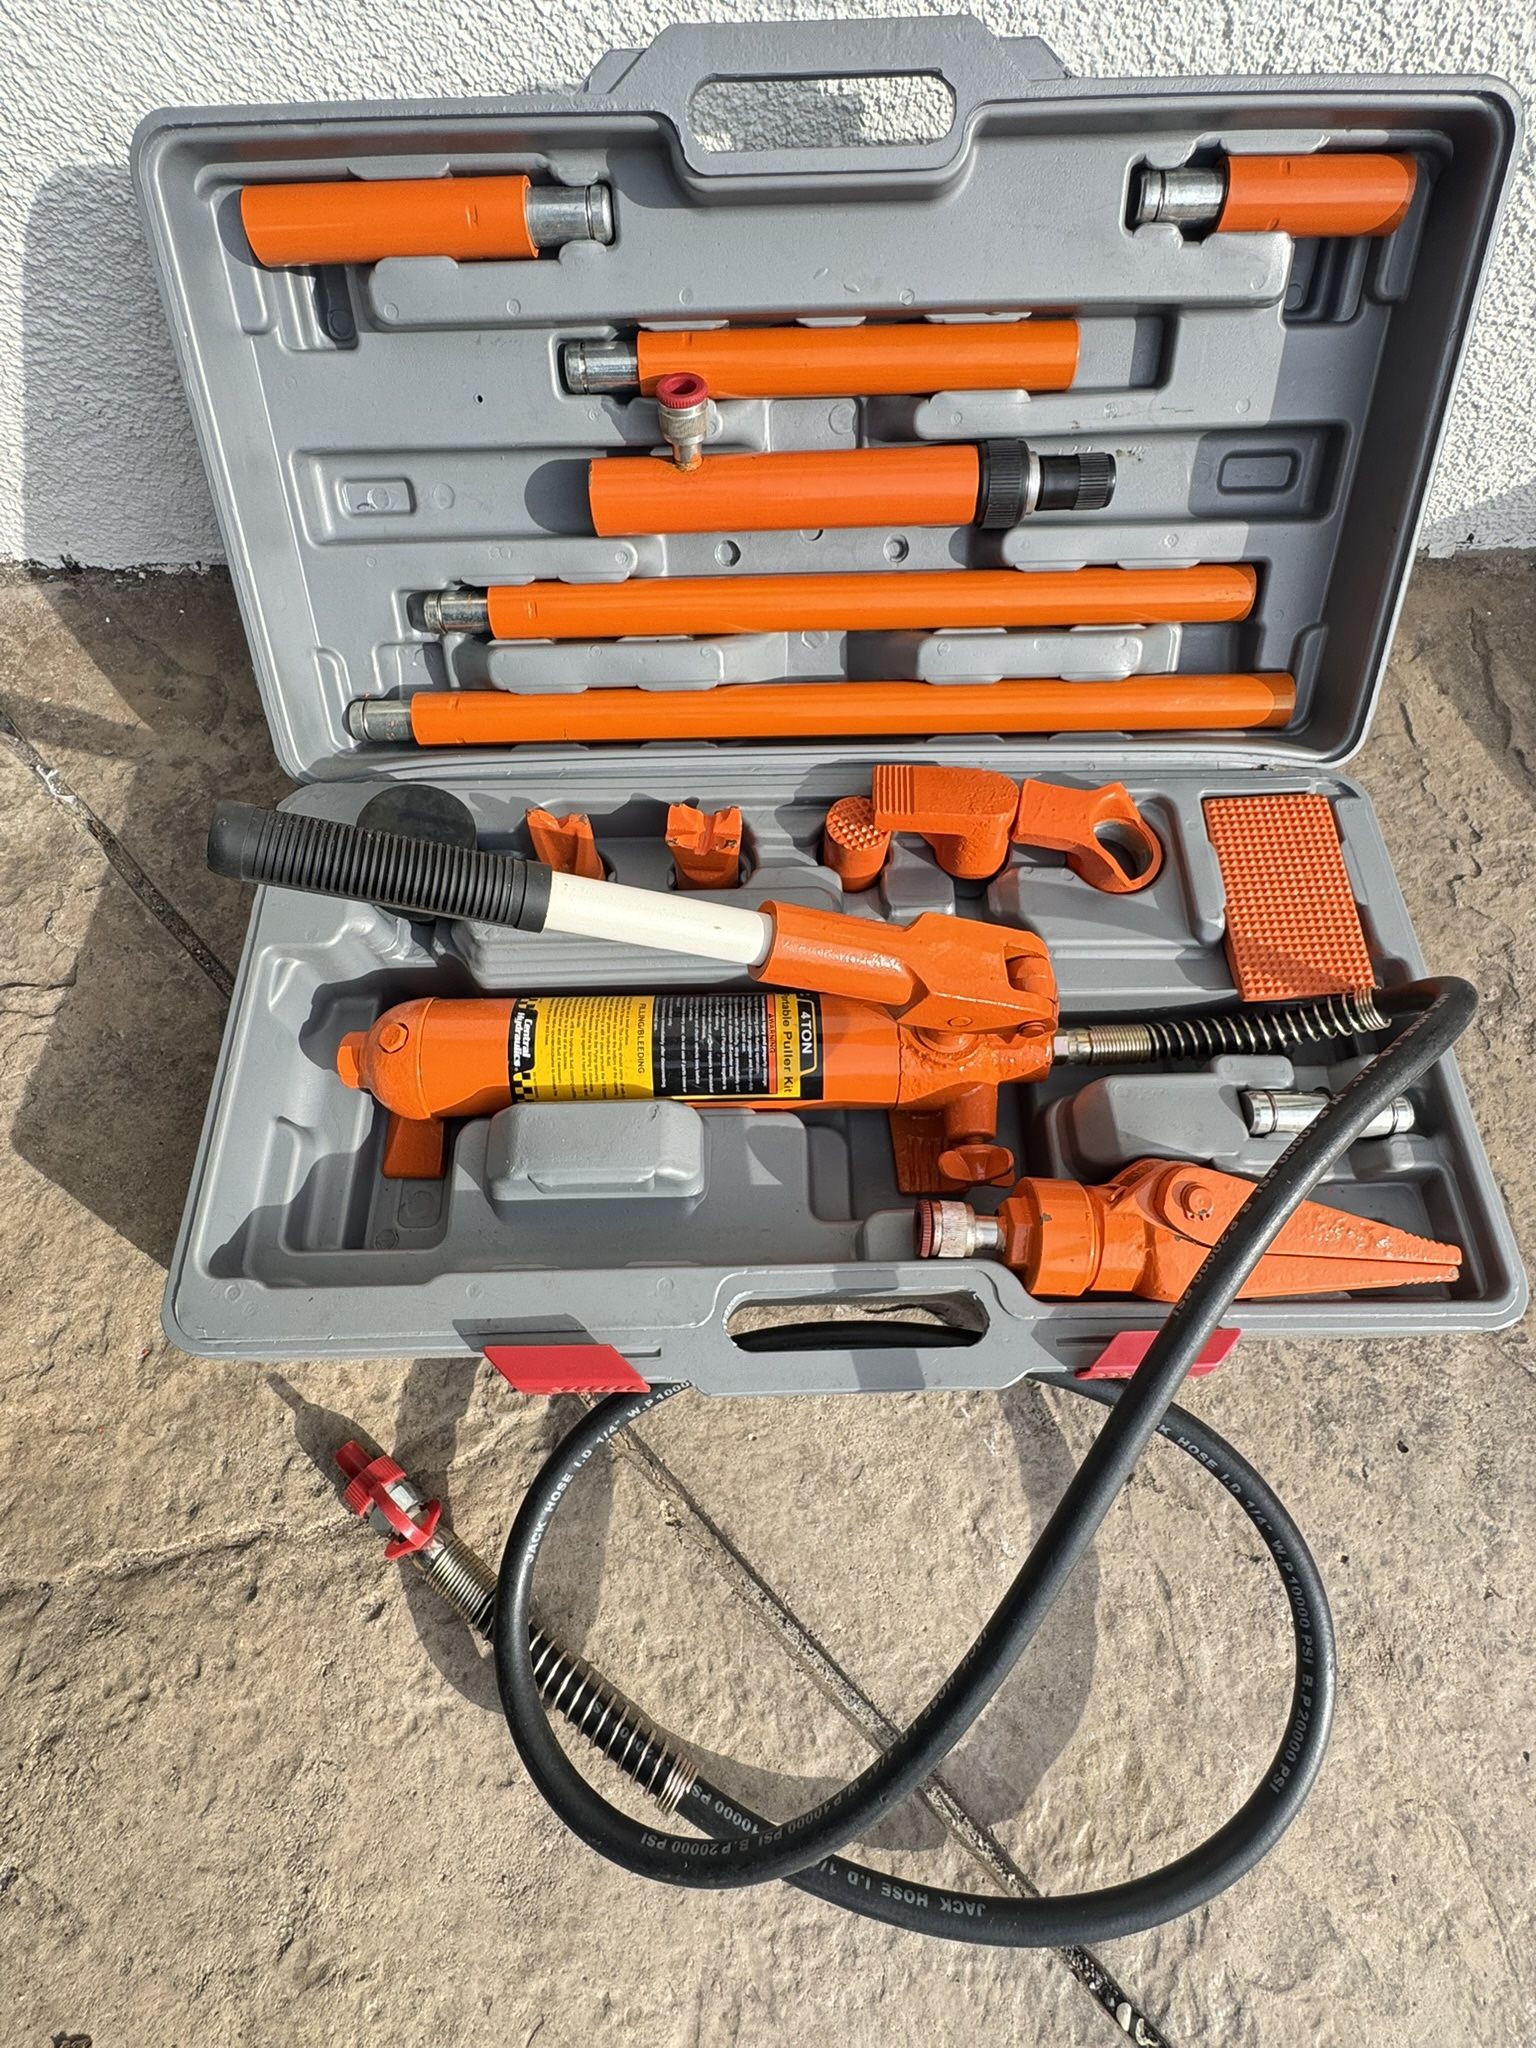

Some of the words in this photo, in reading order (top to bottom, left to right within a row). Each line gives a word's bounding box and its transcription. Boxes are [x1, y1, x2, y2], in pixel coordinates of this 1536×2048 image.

[781, 994, 792, 1027] ortable
[513, 1012, 526, 1067] Hydraulics
[522, 1018, 533, 1058] Central
[637, 1003, 646, 1074] FILLING/BLEEDING
[783, 1031, 793, 1072] Puller
[784, 1077, 793, 1093] Kit
[1256, 1168, 1279, 1193] PSI
[1173, 1289, 1193, 1316] PSI
[1177, 1436, 1219, 1470] HOSE
[525, 1521, 547, 1563] JACK
[544, 1472, 573, 1512] HOSE
[656, 1381, 692, 1401] 1000
[1301, 1633, 1314, 1665] PSI
[1268, 1766, 1291, 1793] PSI
[691, 1784, 711, 1805] PS
[714, 1800, 760, 1836] 10000
[640, 1832, 667, 1849] PSI
[672, 1840, 720, 1857] 20000
[758, 1829, 782, 1847] PSI
[881, 1881, 929, 1908] HOSE
[939, 1898, 987, 1917] JACK
